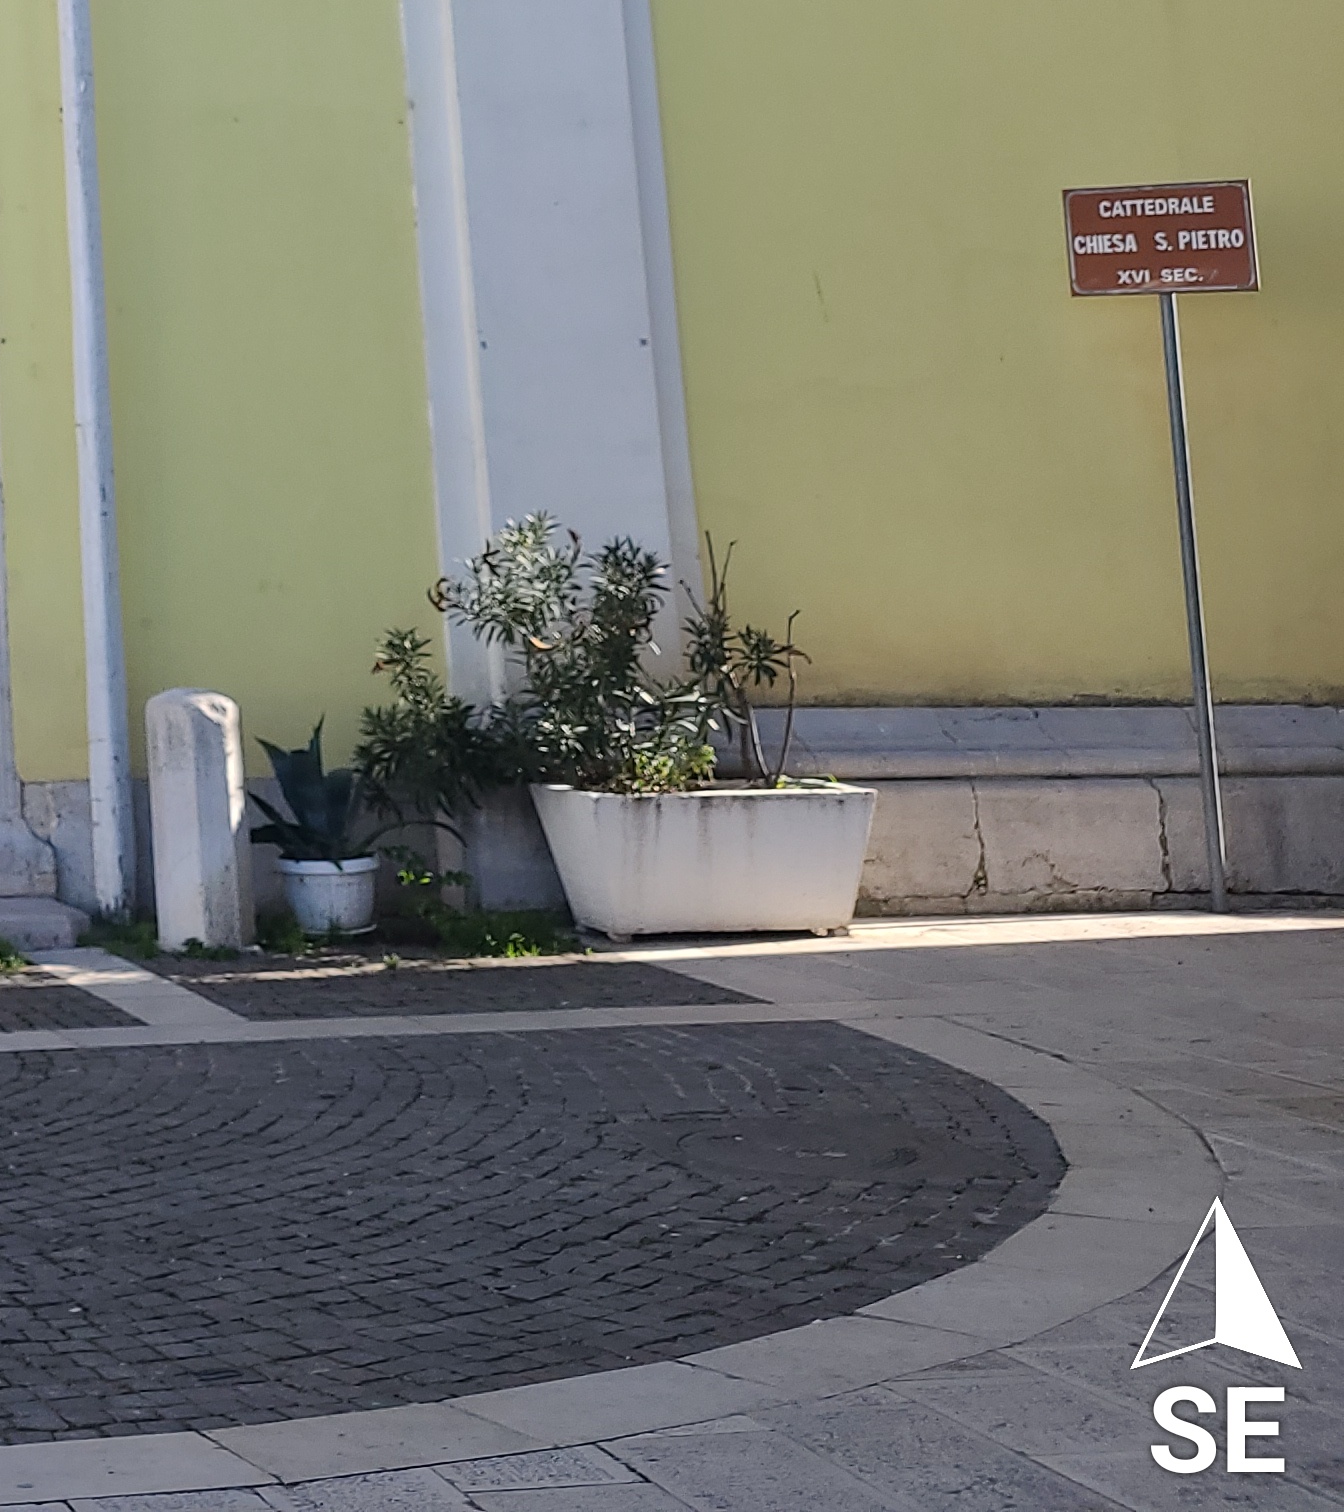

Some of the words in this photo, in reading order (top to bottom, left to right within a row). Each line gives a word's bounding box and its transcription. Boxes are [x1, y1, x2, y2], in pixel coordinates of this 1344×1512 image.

[1098, 195, 1215, 218] CATTEDRALE
[1073, 233, 1138, 255] CHIESA
[1153, 232, 1174, 252] S.
[1178, 228, 1245, 251] PIETRO
[1117, 269, 1151, 285] XVI
[1160, 267, 1204, 284] SEC.
